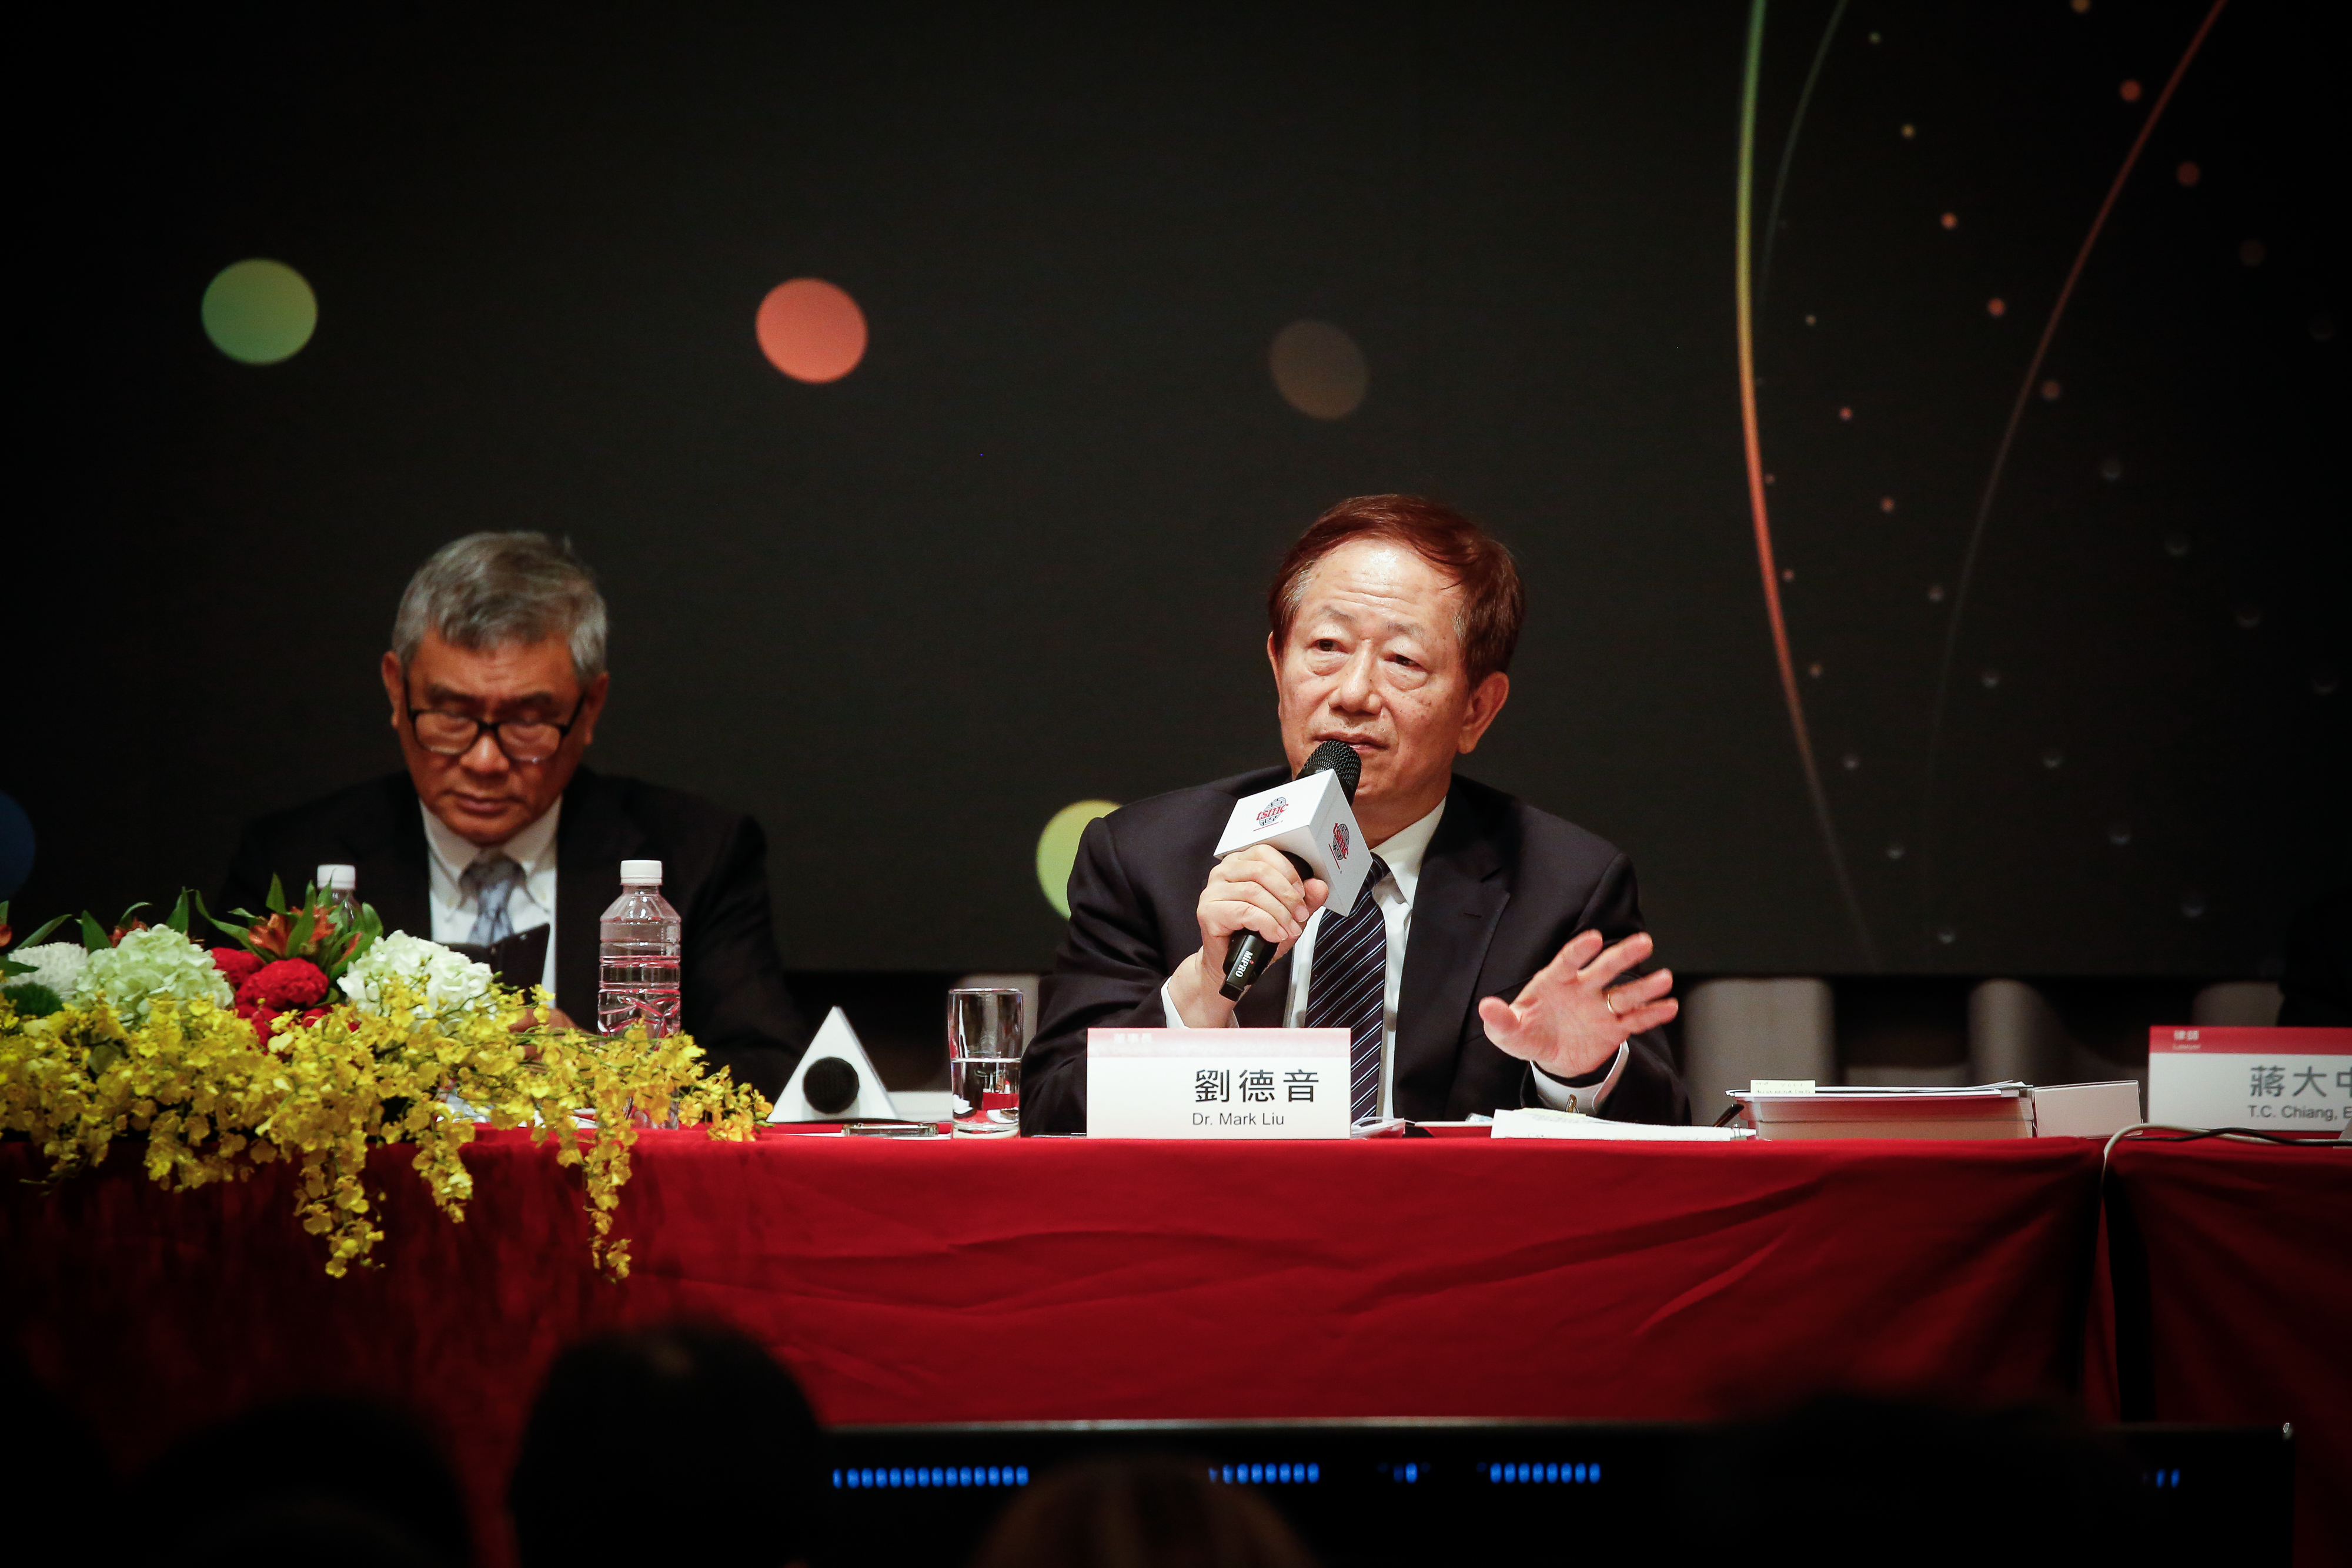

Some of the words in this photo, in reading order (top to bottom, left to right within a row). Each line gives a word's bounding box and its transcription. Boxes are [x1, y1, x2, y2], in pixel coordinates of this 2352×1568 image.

[1257, 804, 1289, 821] tsmc
[1235, 951, 1254, 977] MIPRO
[1195, 1069, 1319, 1102] 劉德音
[1192, 1113, 1213, 1125] Dr.
[1220, 1112, 1257, 1125] Mark
[1262, 1112, 1284, 1125] Liu
[2248, 1105, 2276, 1118] T.C.
[2281, 1105, 2337, 1122] Chiang,
